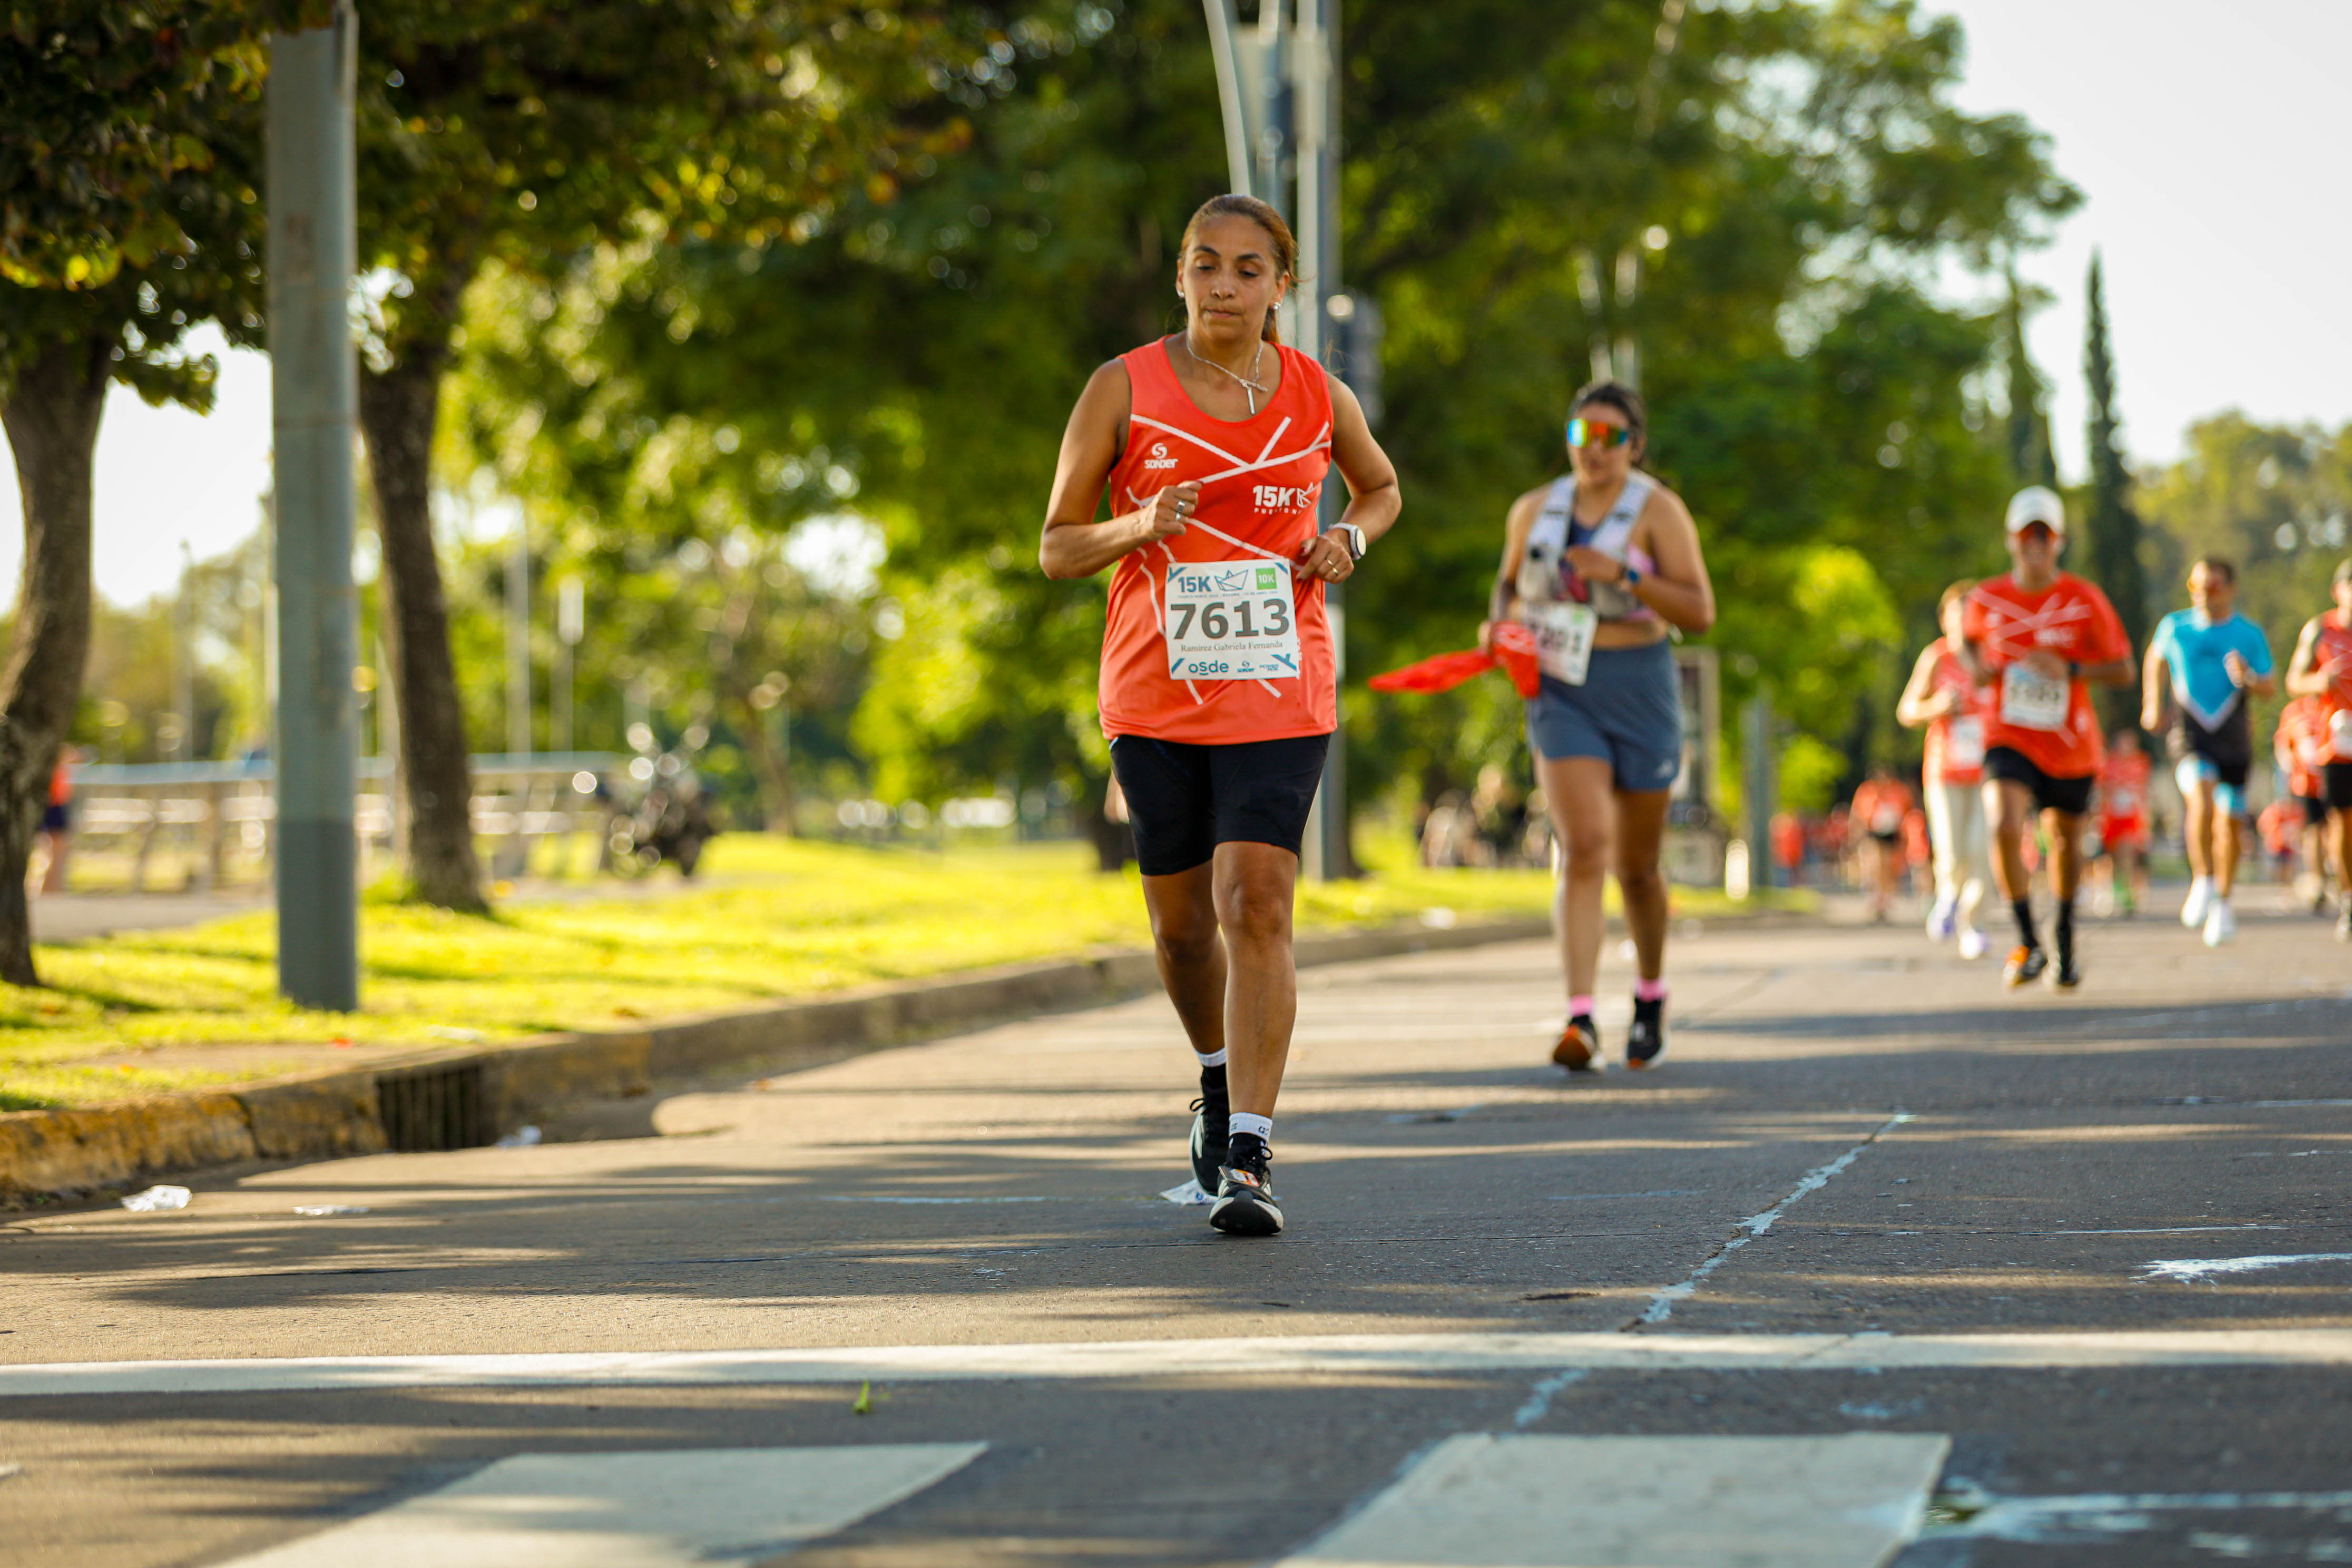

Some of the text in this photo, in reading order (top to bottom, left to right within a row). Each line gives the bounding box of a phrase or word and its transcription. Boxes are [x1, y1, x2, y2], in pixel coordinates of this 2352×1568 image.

[1253, 485, 1296, 507] 15K
[1178, 576, 1211, 592] 15K
[1258, 574, 1275, 583] 10K
[1170, 599, 1289, 639] 7613
[1214, 642, 1246, 651] Gabriela
[1249, 640, 1283, 649] Fernanda
[1189, 660, 1229, 673] osde
